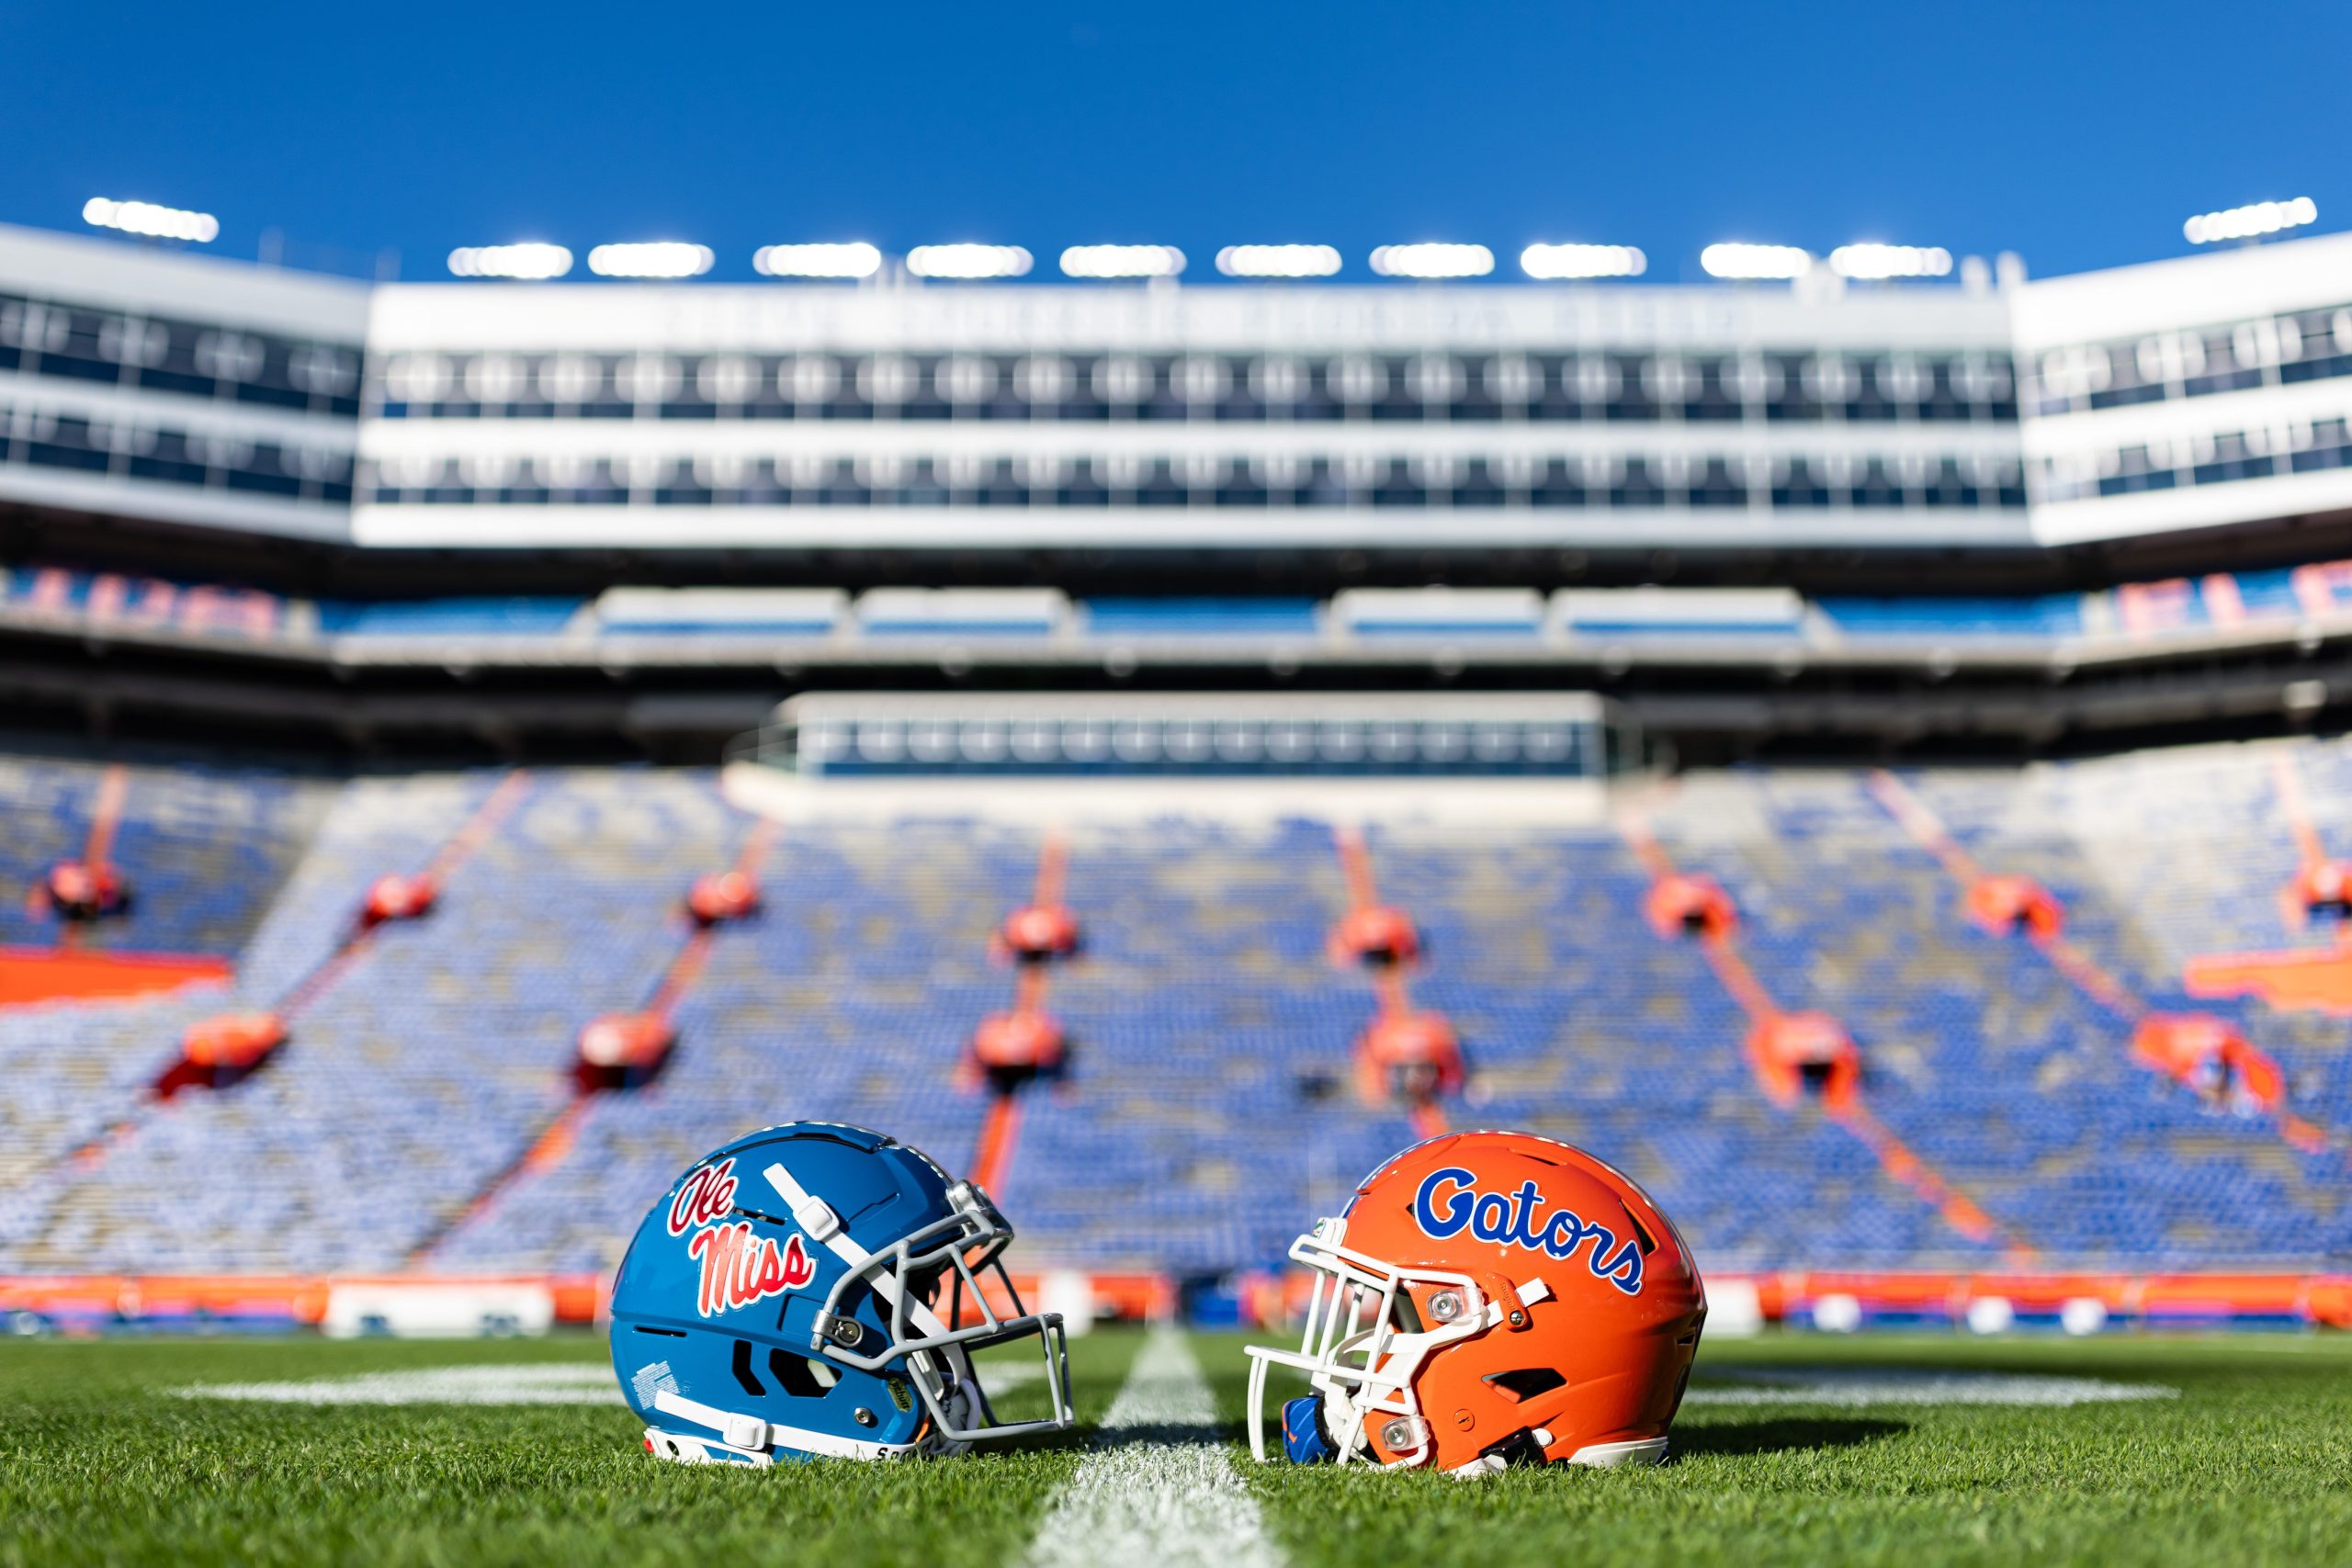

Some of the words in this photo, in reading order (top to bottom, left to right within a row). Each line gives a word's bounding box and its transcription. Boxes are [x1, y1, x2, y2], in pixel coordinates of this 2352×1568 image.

[669, 1158, 738, 1235] Ole
[1415, 1168, 1644, 1295] Gators
[689, 1222, 816, 1316] Miss
